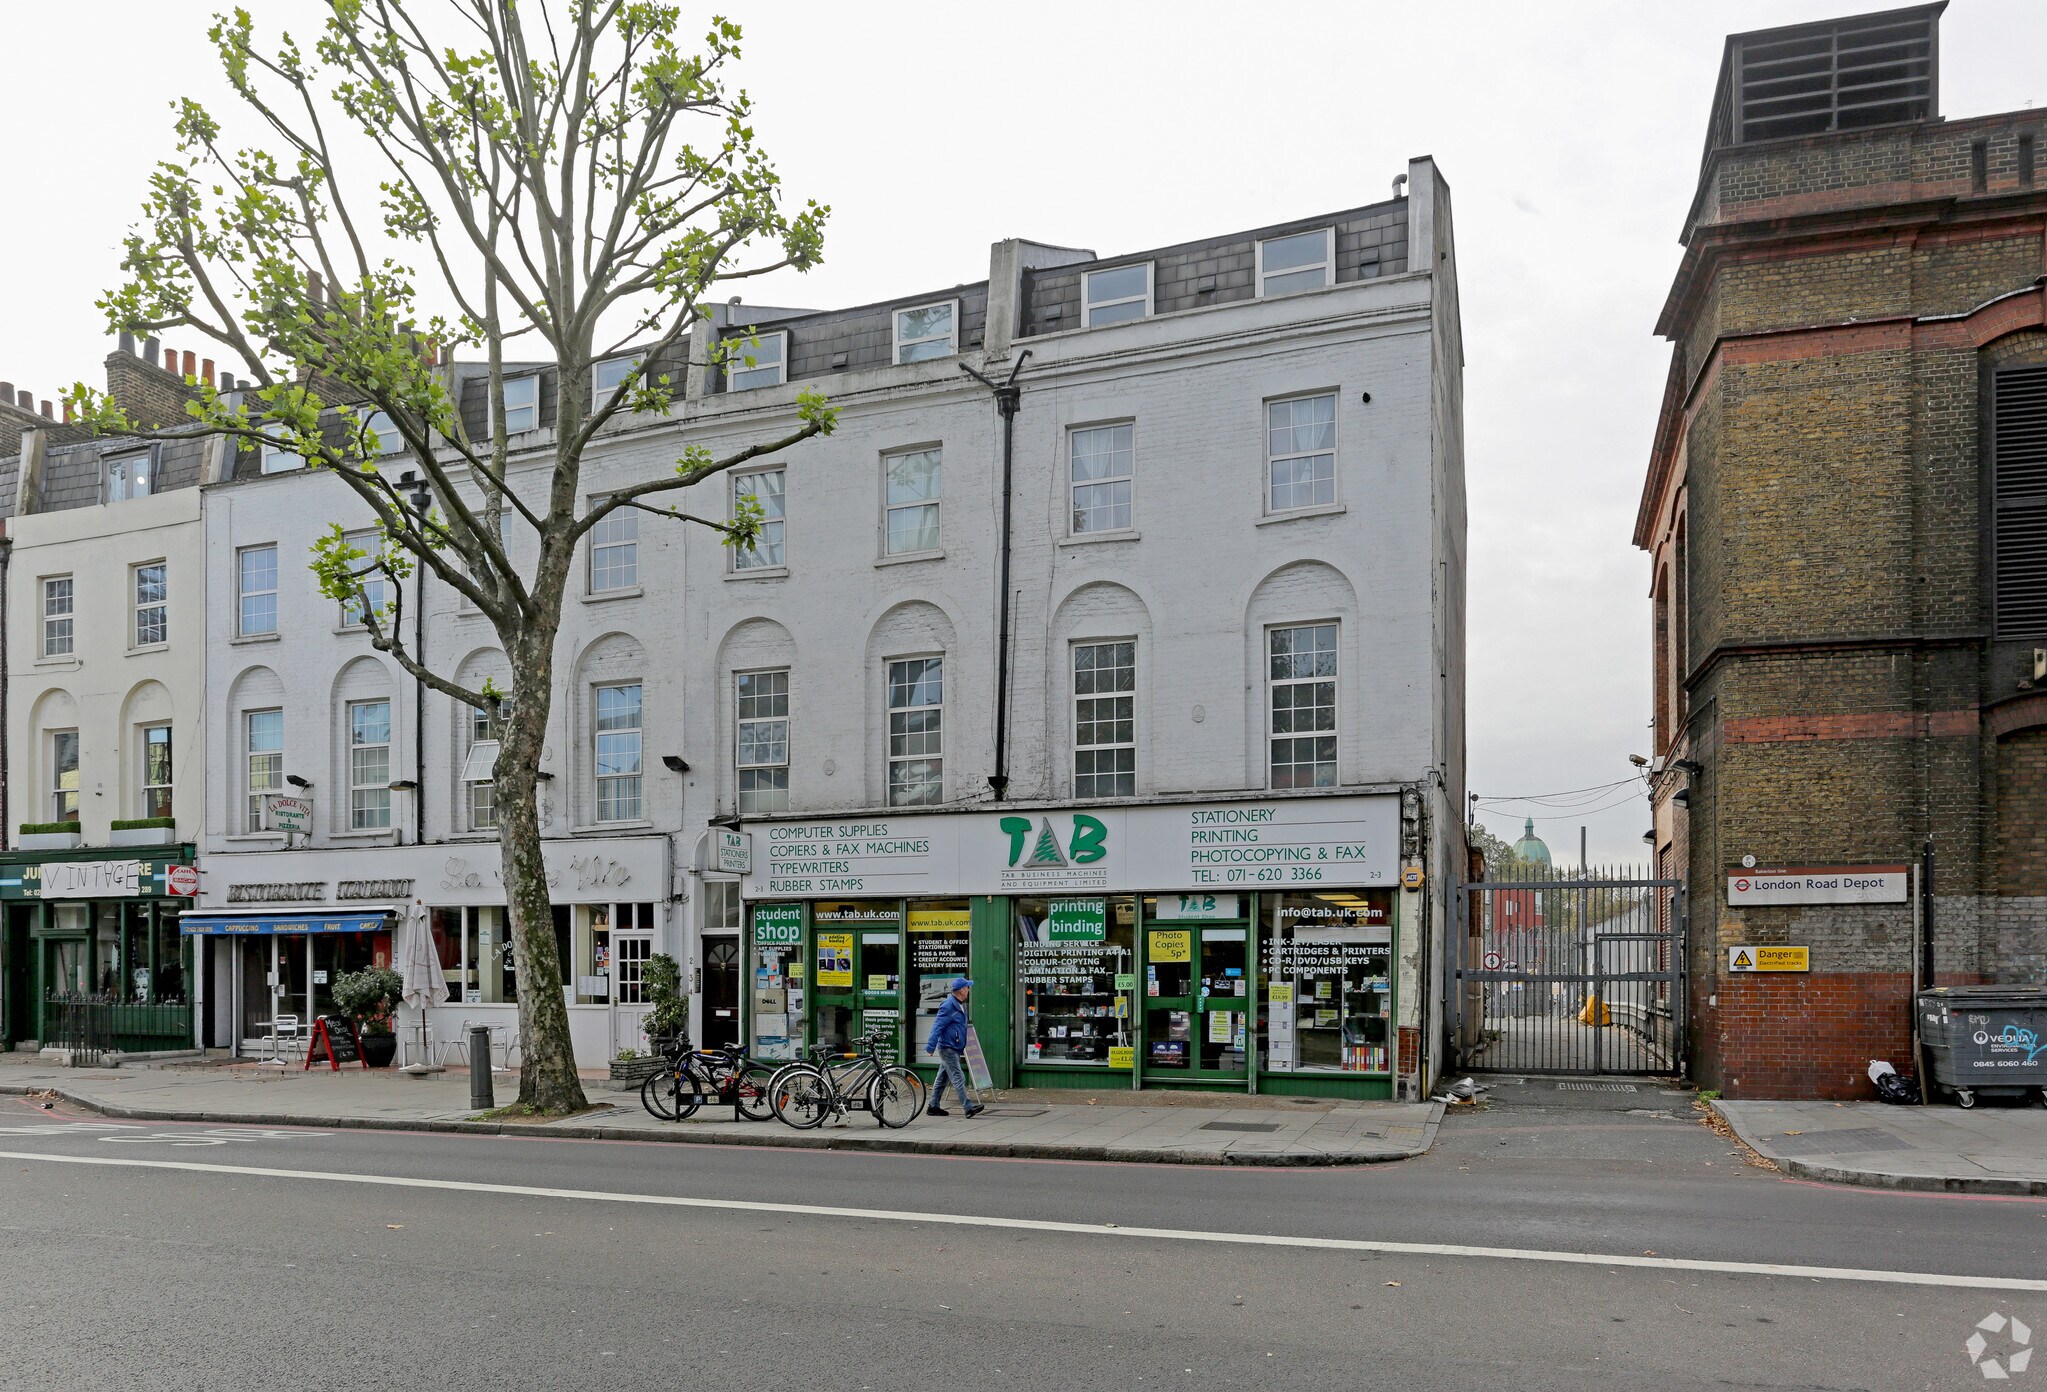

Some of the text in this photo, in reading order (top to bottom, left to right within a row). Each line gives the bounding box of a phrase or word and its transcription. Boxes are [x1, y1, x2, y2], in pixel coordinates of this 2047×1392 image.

[269, 800, 310, 816] LA DOLCE VITA
[275, 810, 304, 819] RISTORANTE
[1192, 808, 1276, 824] STATIONERY
[770, 824, 888, 840] COMPUTER SUPPLIES
[1192, 829, 1258, 843] PRINTING
[726, 834, 741, 847] TAB
[1000, 814, 1108, 868] TAB
[720, 848, 748, 860] STATIONERS
[770, 840, 930, 857] COPIERS & FAX MACHINES
[1192, 846, 1366, 862] PHOTOCOPYING & FAX
[724, 859, 746, 868] PRINTERS
[770, 862, 849, 874] TYPEWRITERS
[44, 860, 140, 891] VINTAGE
[1192, 870, 1220, 882] TEL:
[1291, 867, 1322, 880] 3366
[770, 878, 864, 892] RUBBER STAMPS
[1755, 878, 1884, 890] London Road Depot
[1050, 900, 1104, 916] printing
[1178, 894, 1216, 912] TAB
[756, 908, 800, 920] student
[816, 910, 900, 920] www.tab.uk.com
[1277, 907, 1382, 918] info@tab.uk.com
[757, 922, 800, 943] shop
[1052, 920, 1103, 935] binding
[1155, 941, 1184, 950] Copies
[1269, 957, 1342, 965] CD-R/DVD/USB
[1759, 950, 1792, 960] Danger
[1283, 966, 1348, 974] COMPONENTS
[325, 1020, 341, 1028] Meal
[335, 1026, 348, 1034] Deal
